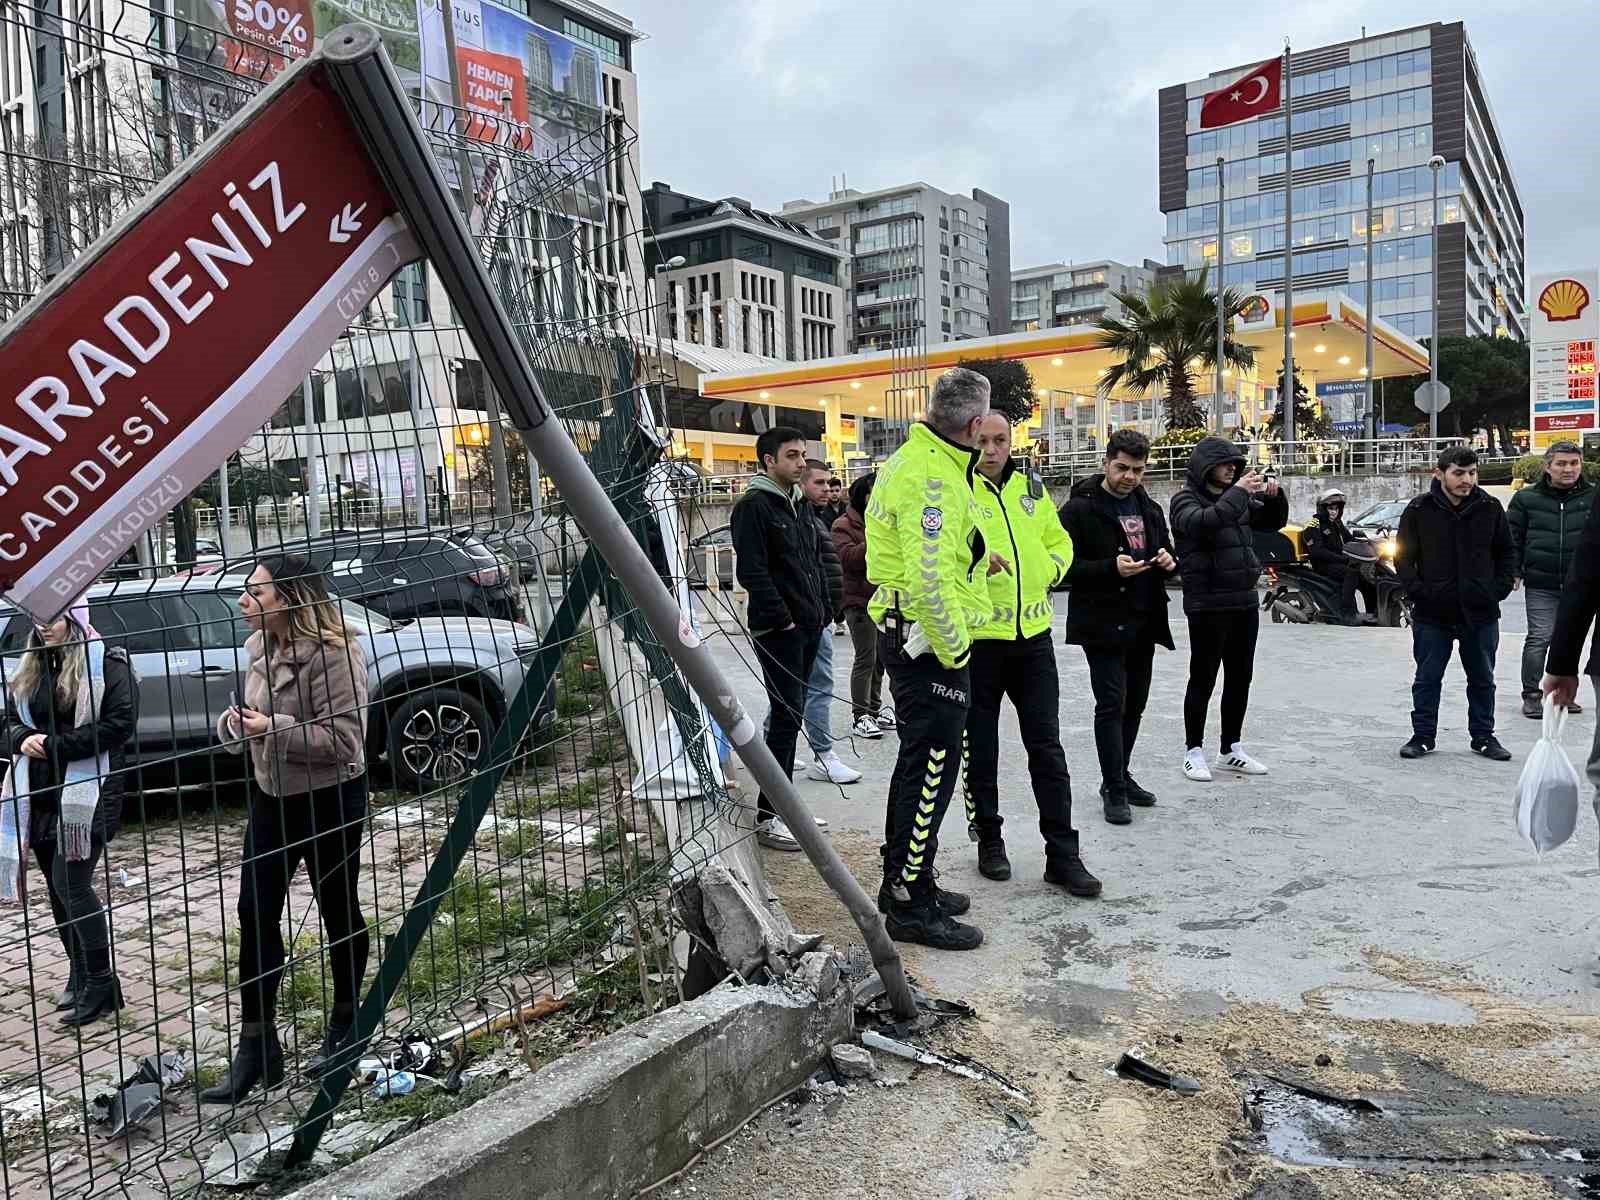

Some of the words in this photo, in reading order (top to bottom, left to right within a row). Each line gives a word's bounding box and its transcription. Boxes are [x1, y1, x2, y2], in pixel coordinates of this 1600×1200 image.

[233, 0, 307, 42] 50%
[466, 61, 513, 90] HEMEN
[0, 160, 306, 496] ARADENİZ
[0, 395, 169, 561] CADDESİ
[51, 475, 184, 597] BEYLİKDÜZÜ
